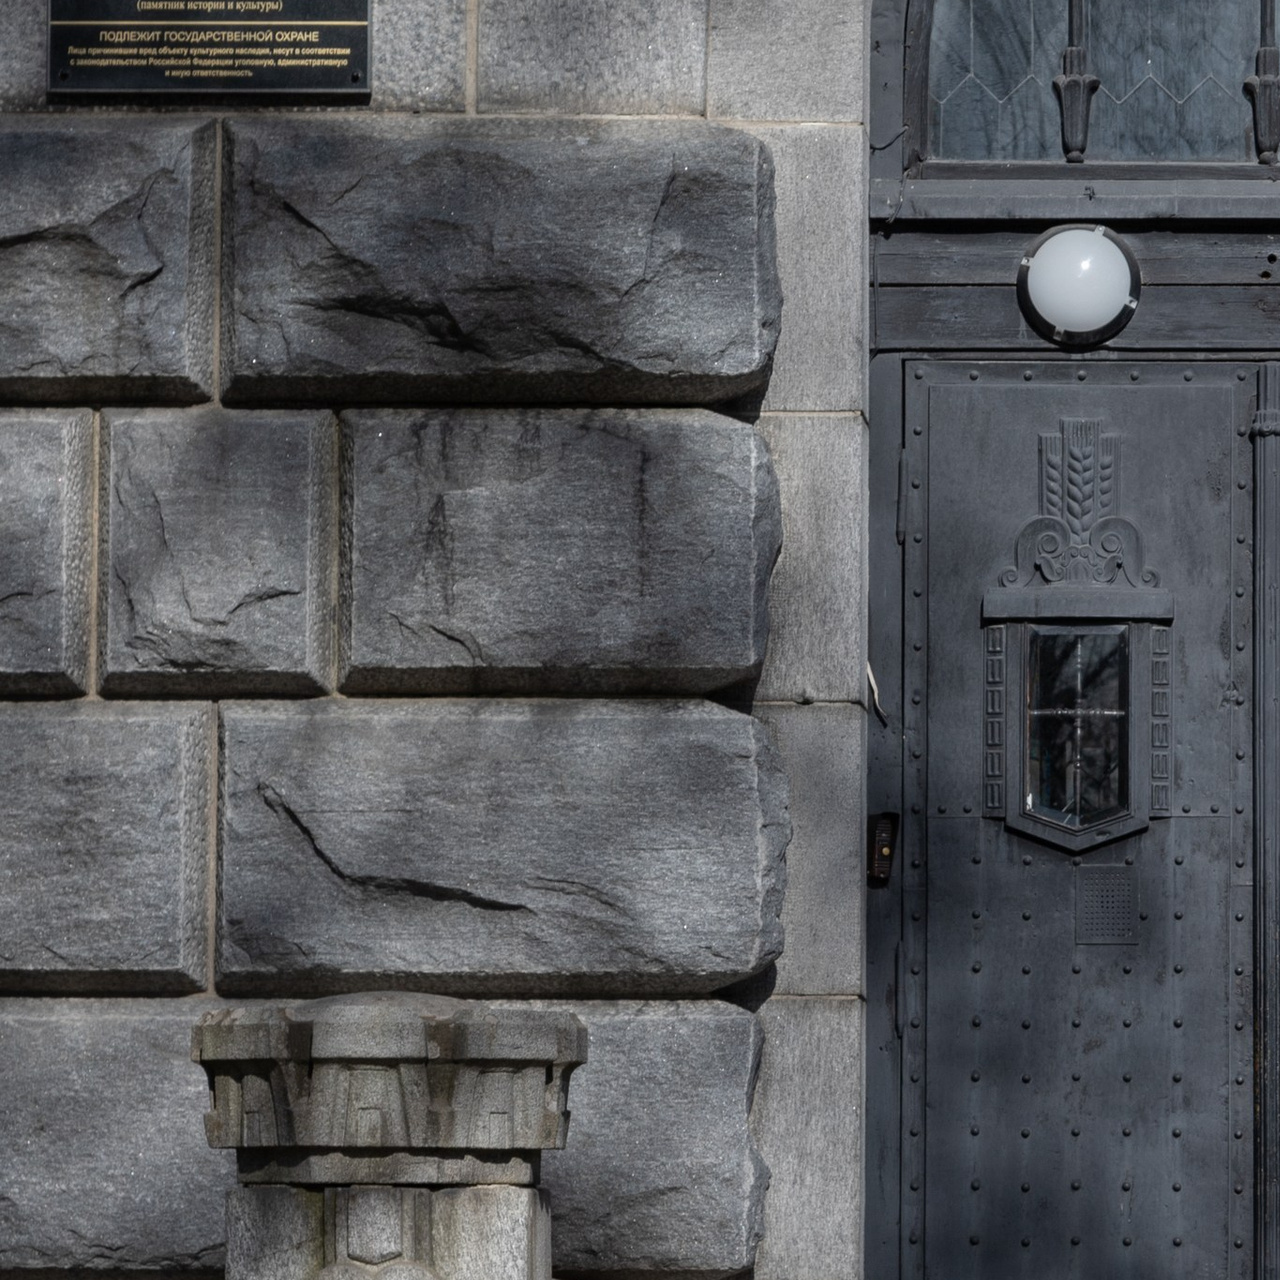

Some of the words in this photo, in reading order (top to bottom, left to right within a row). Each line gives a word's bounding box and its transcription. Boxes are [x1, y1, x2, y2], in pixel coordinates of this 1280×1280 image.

[136, 0, 186, 12] (памятник
[186, 0, 226, 13] истории
[227, 1, 235, 10] и
[235, 0, 284, 13] культуры)
[99, 31, 161, 43] ПОДЛЕЖИТ
[164, 29, 274, 43] ГОСУДАРСТВЕННОЙ
[275, 31, 320, 43] ОХРАНЕ
